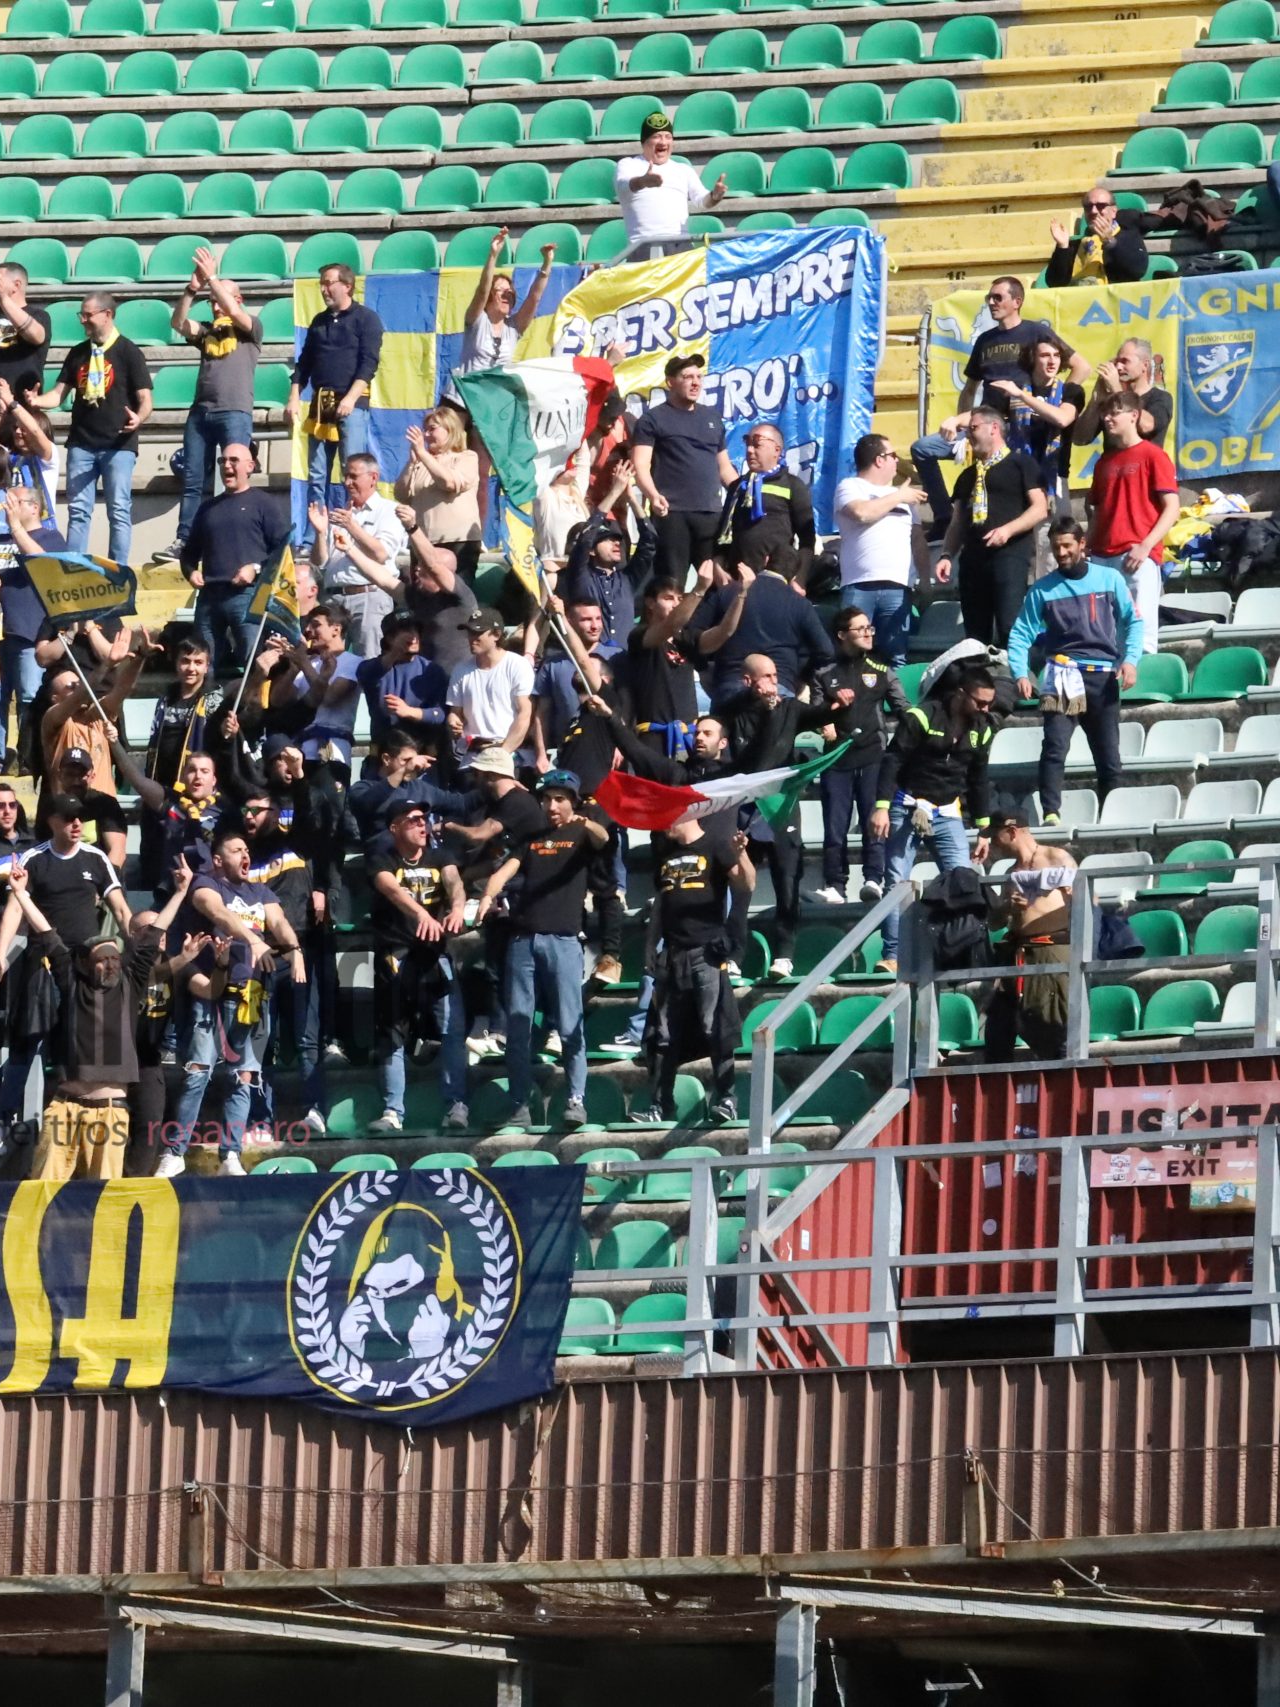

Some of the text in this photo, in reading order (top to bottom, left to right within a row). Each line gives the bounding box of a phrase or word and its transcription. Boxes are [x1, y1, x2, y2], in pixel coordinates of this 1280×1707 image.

[590, 298, 677, 360] PER
[677, 238, 857, 340] SEMPRE
[1166, 1157, 1221, 1178] EXIT
